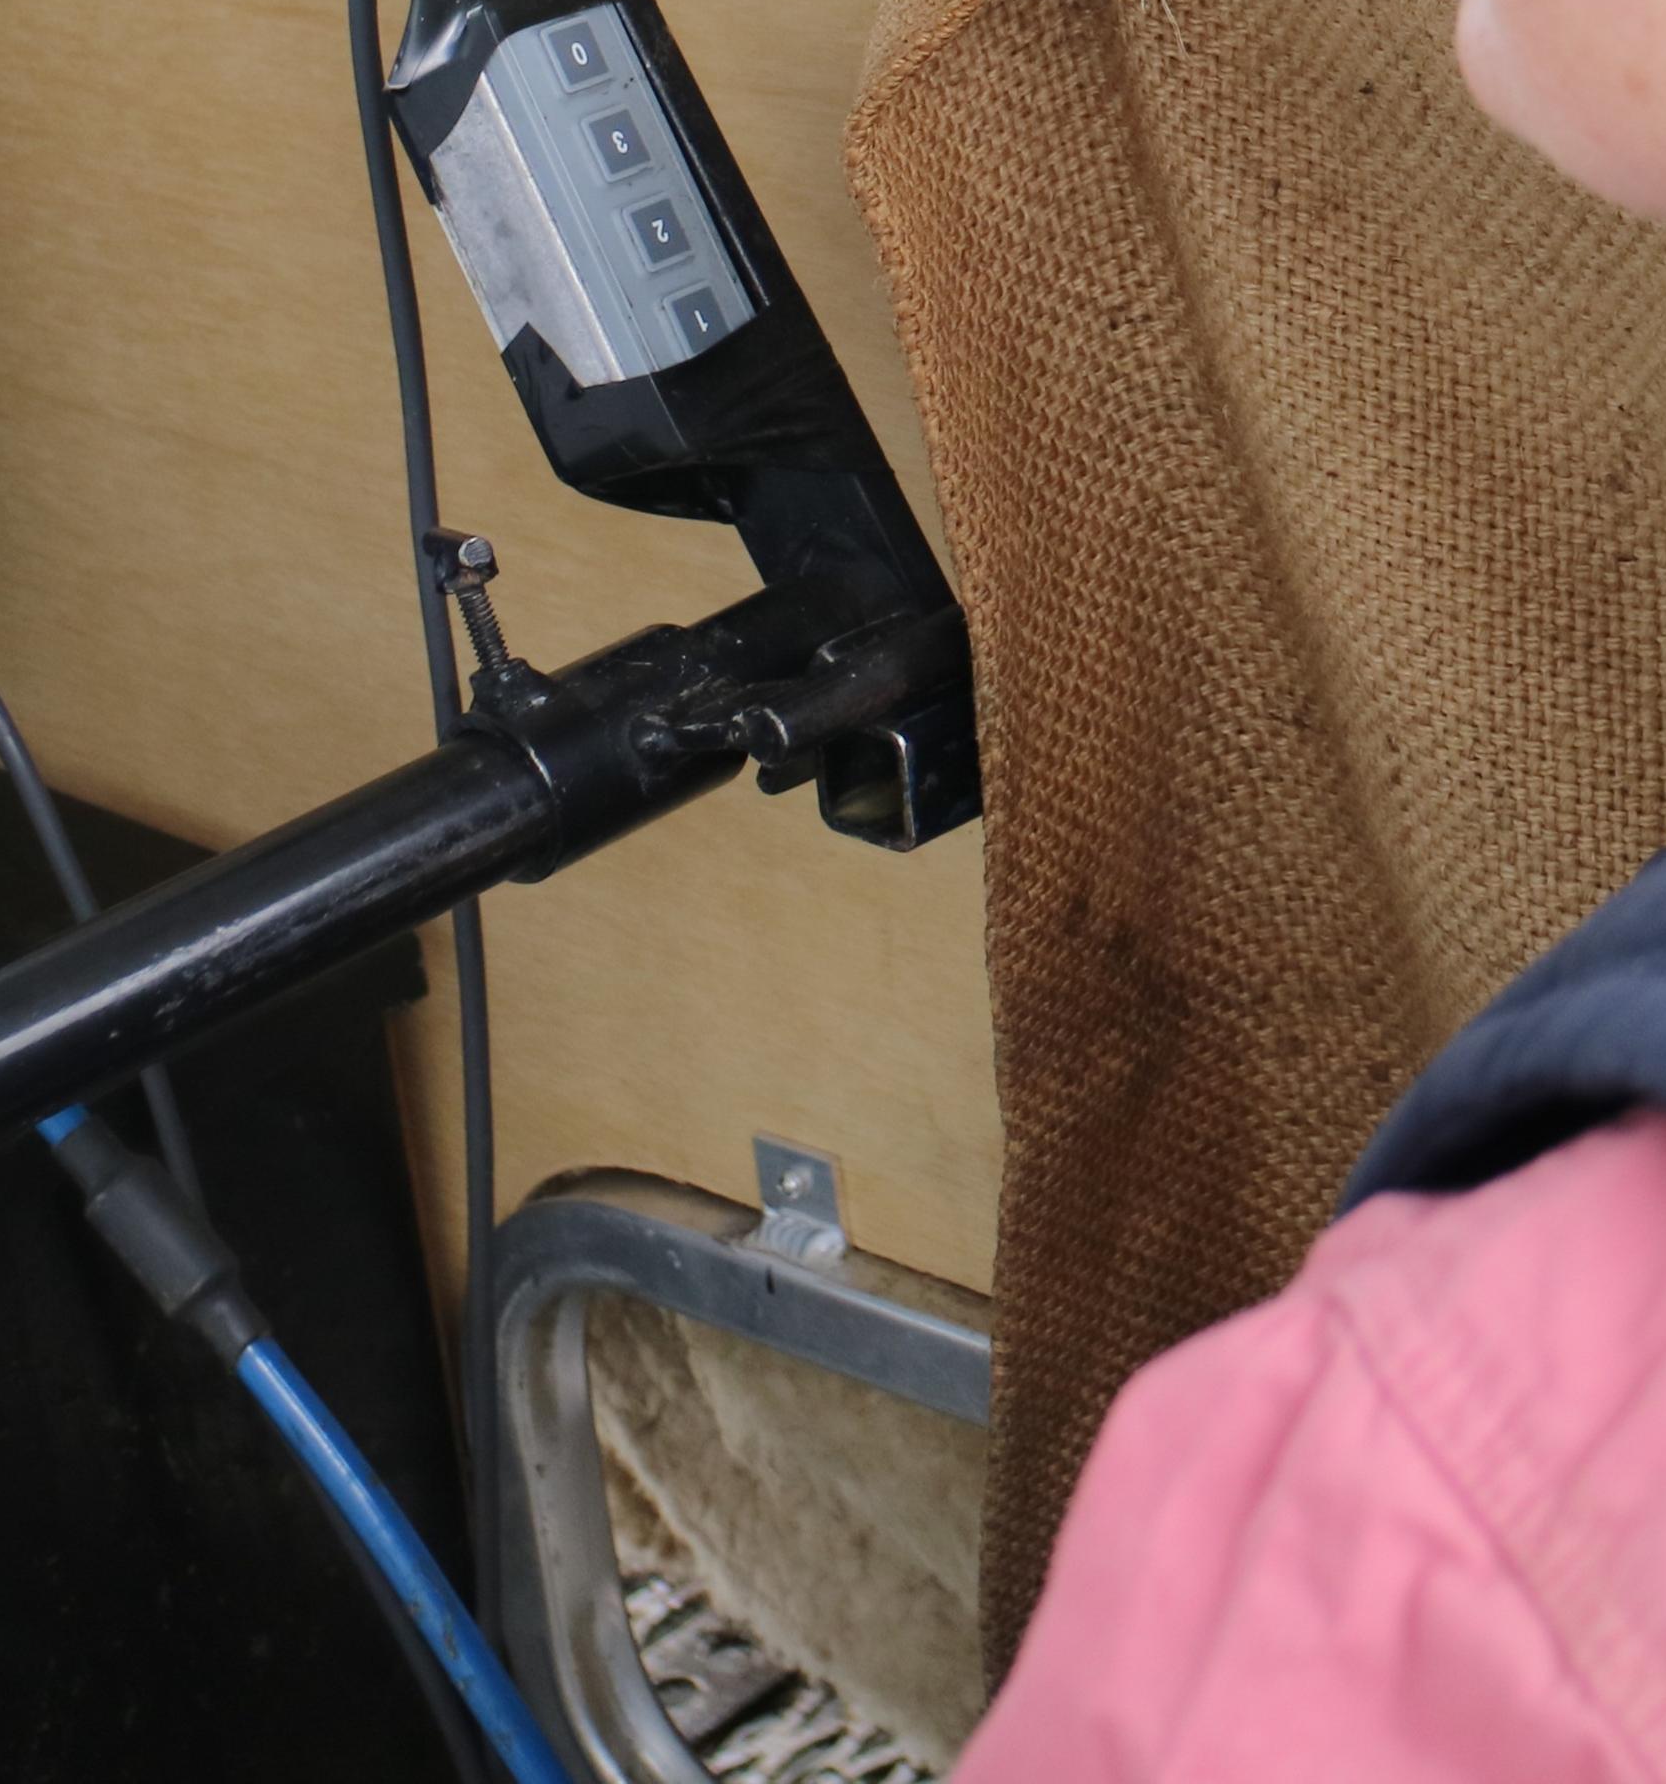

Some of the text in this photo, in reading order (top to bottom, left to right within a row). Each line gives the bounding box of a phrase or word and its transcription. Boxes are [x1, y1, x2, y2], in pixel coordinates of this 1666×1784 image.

[571, 42, 588, 66] 0
[610, 129, 630, 154] 3
[650, 217, 670, 243] 2
[692, 309, 709, 334] 1
